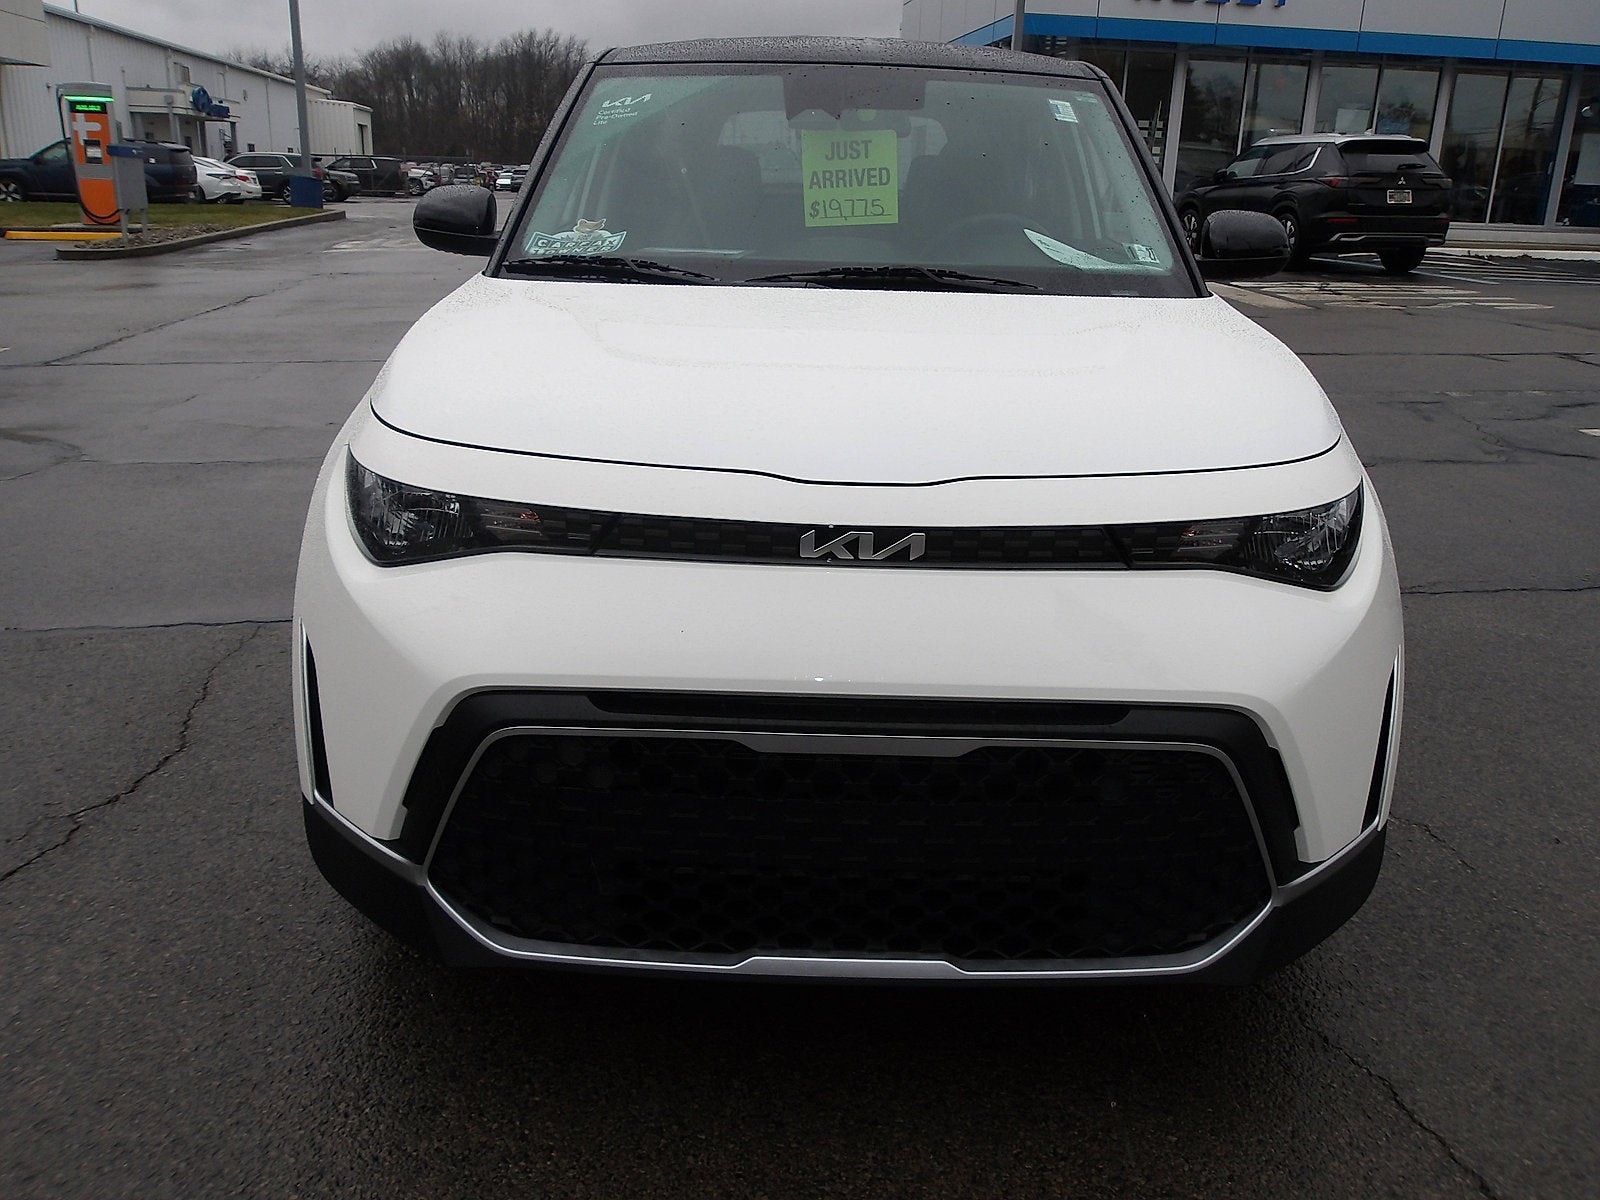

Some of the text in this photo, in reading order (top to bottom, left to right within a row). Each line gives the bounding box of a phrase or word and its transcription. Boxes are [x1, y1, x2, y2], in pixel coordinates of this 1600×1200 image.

[825, 140, 872, 161] JUST
[808, 167, 891, 189] ARRIVED
[809, 198, 885, 221] $19,775
[537, 239, 618, 248] CARFAX
[800, 529, 926, 561] KIA
